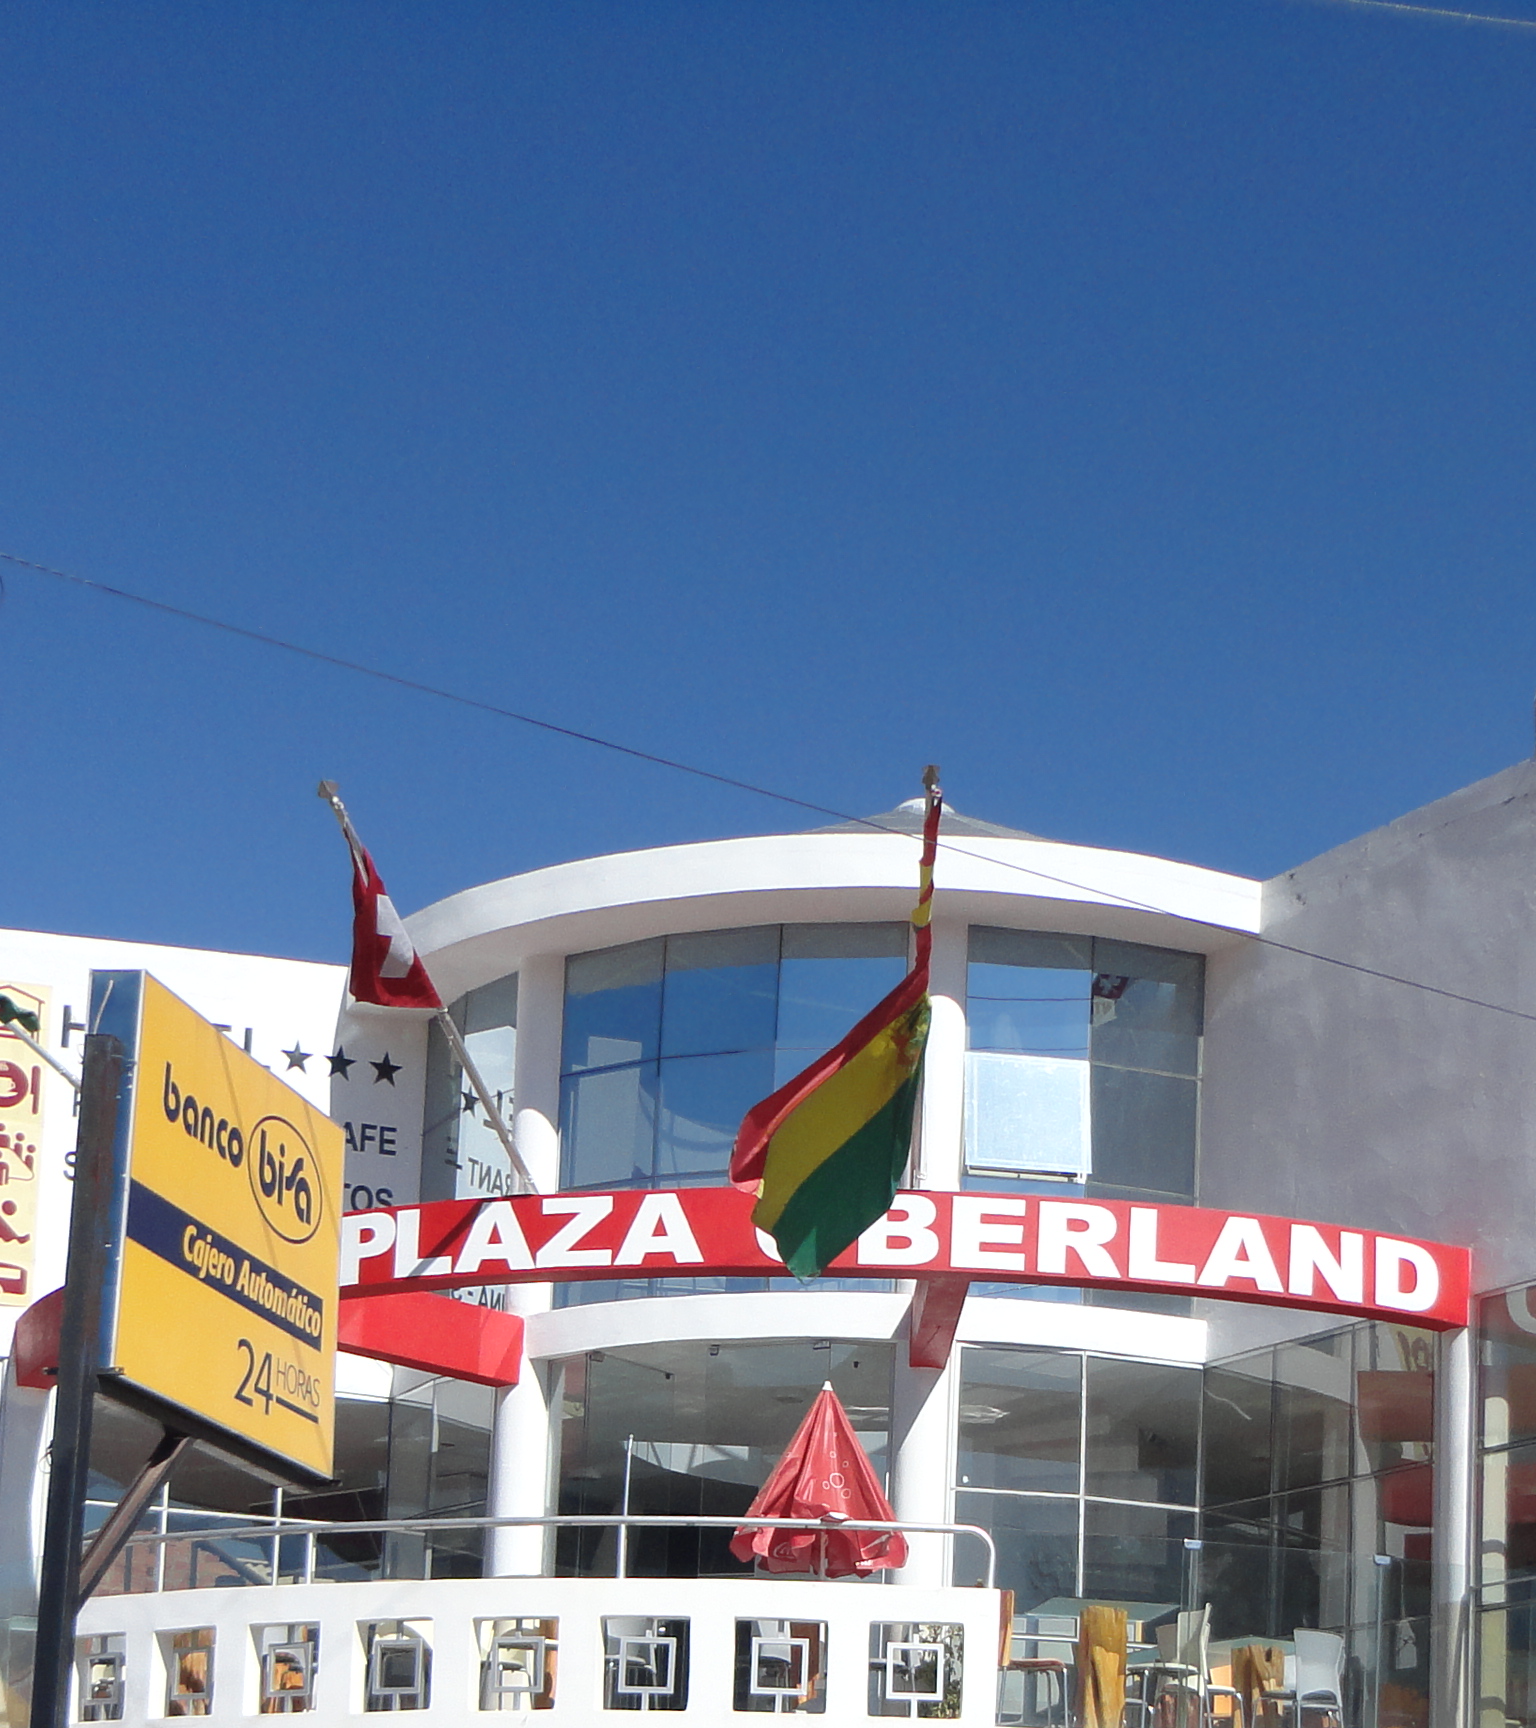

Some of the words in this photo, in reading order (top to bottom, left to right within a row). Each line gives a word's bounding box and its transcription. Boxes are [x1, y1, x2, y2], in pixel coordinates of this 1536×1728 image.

[164, 1061, 244, 1168] banco
[259, 1128, 311, 1226] bisa
[344, 1121, 397, 1156] AFE
[183, 1224, 235, 1285] Cajero
[236, 1259, 322, 1338] Automático
[339, 1192, 704, 1287] PLAZA
[753, 1192, 1440, 1313] BERLAND
[234, 1338, 274, 1416] 24
[276, 1357, 321, 1408] HORAS
